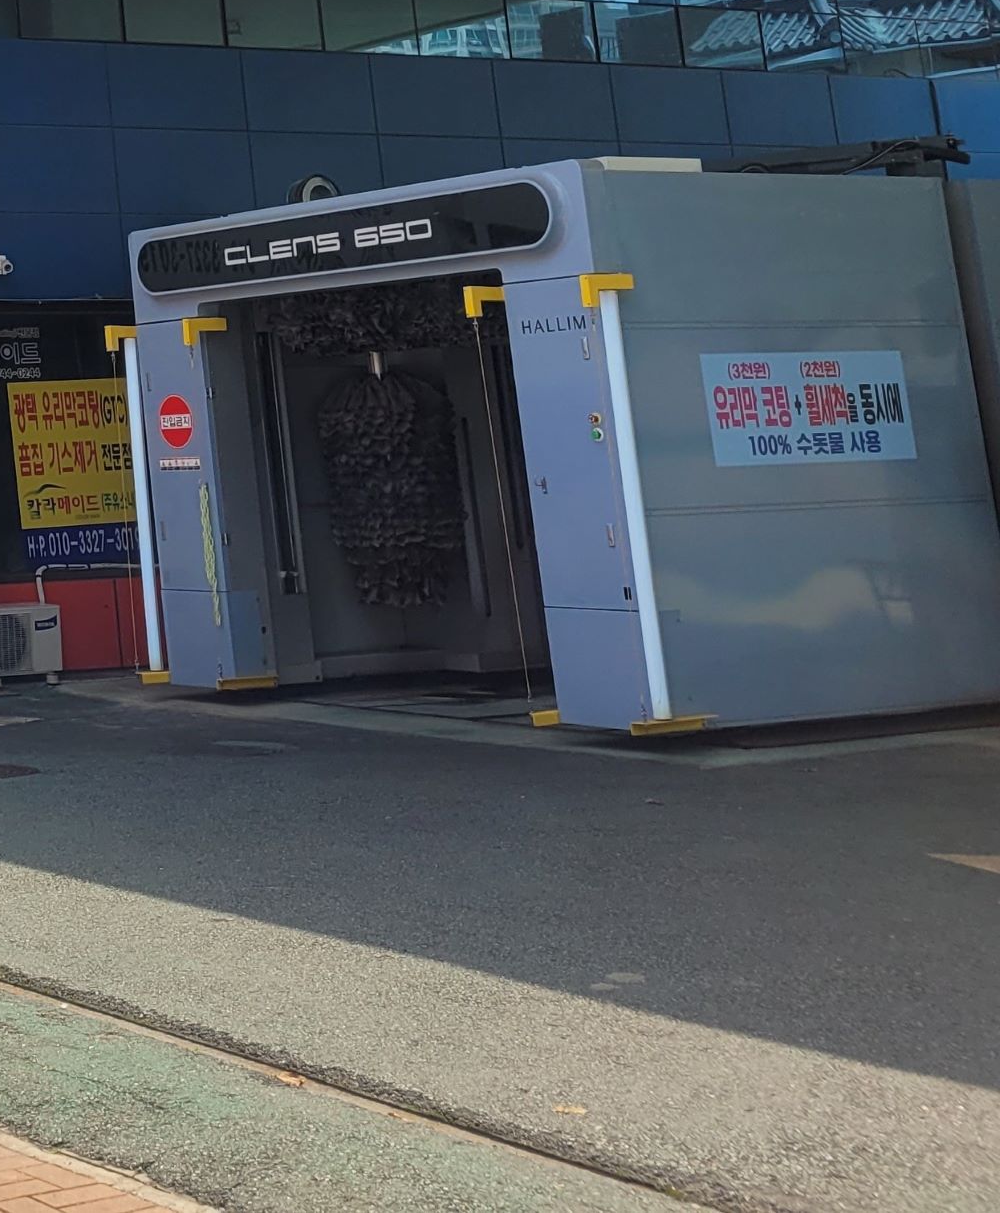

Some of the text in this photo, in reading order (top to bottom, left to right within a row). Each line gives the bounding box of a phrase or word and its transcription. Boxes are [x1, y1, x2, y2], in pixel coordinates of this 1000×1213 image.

[354, 218, 432, 248] 650
[522, 314, 587, 335] HALLIM
[727, 360, 841, 380] (3천원) (2천원)
[13, 392, 38, 433] 광택
[713, 385, 760, 429] 유리막
[760, 386, 792, 428] 코팅
[161, 416, 191, 427] 진입금지
[748, 430, 882, 456] 100% 수돗물 사용
